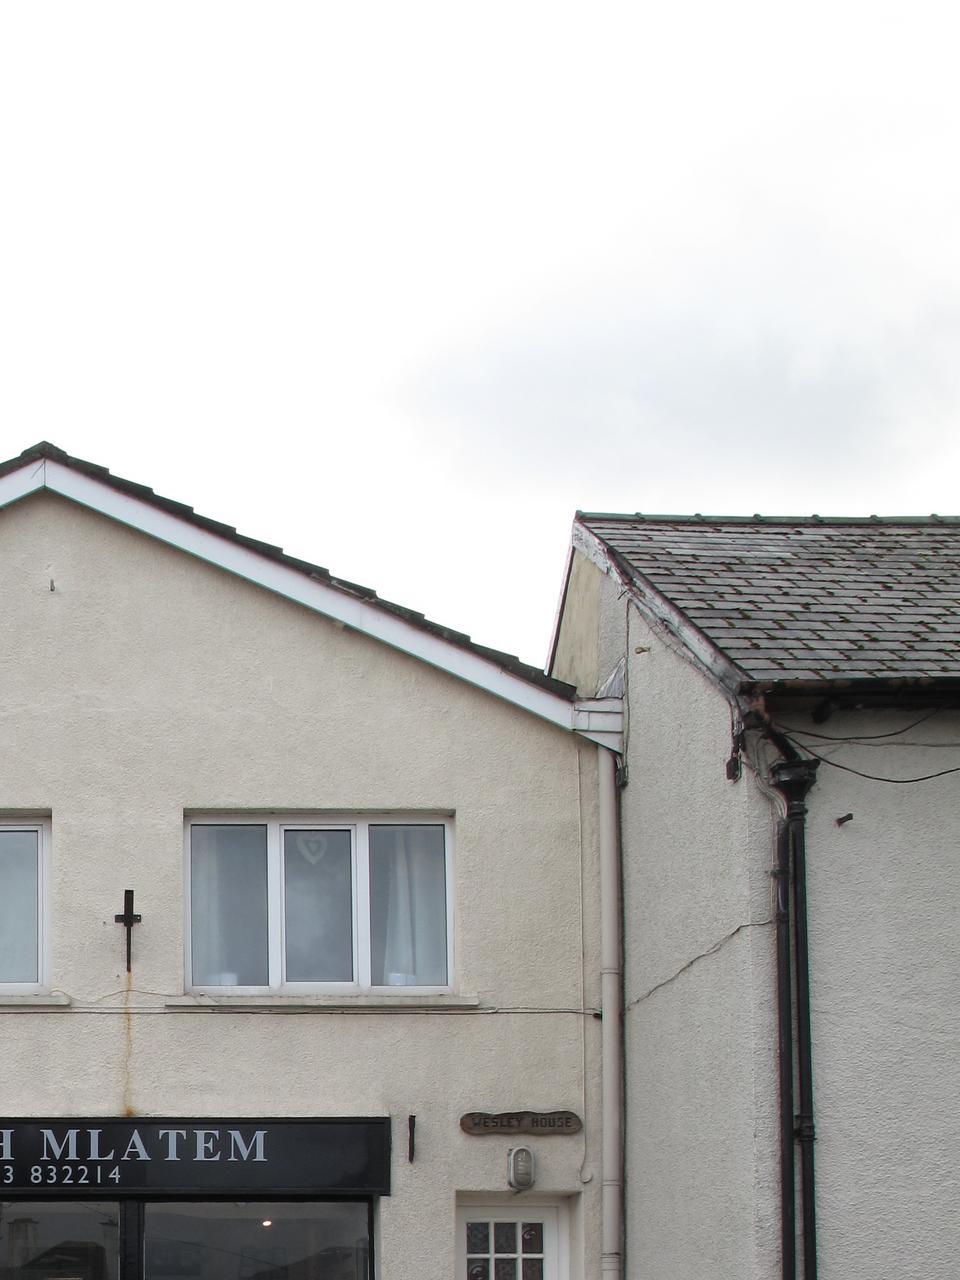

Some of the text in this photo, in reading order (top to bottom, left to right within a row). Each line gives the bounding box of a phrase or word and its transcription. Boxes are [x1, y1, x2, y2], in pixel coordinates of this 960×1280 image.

[472, 1117, 573, 1128] WESLEY HOUSE
[39, 1129, 268, 1162] MLATEM
[30, 1165, 121, 1184] 832214
